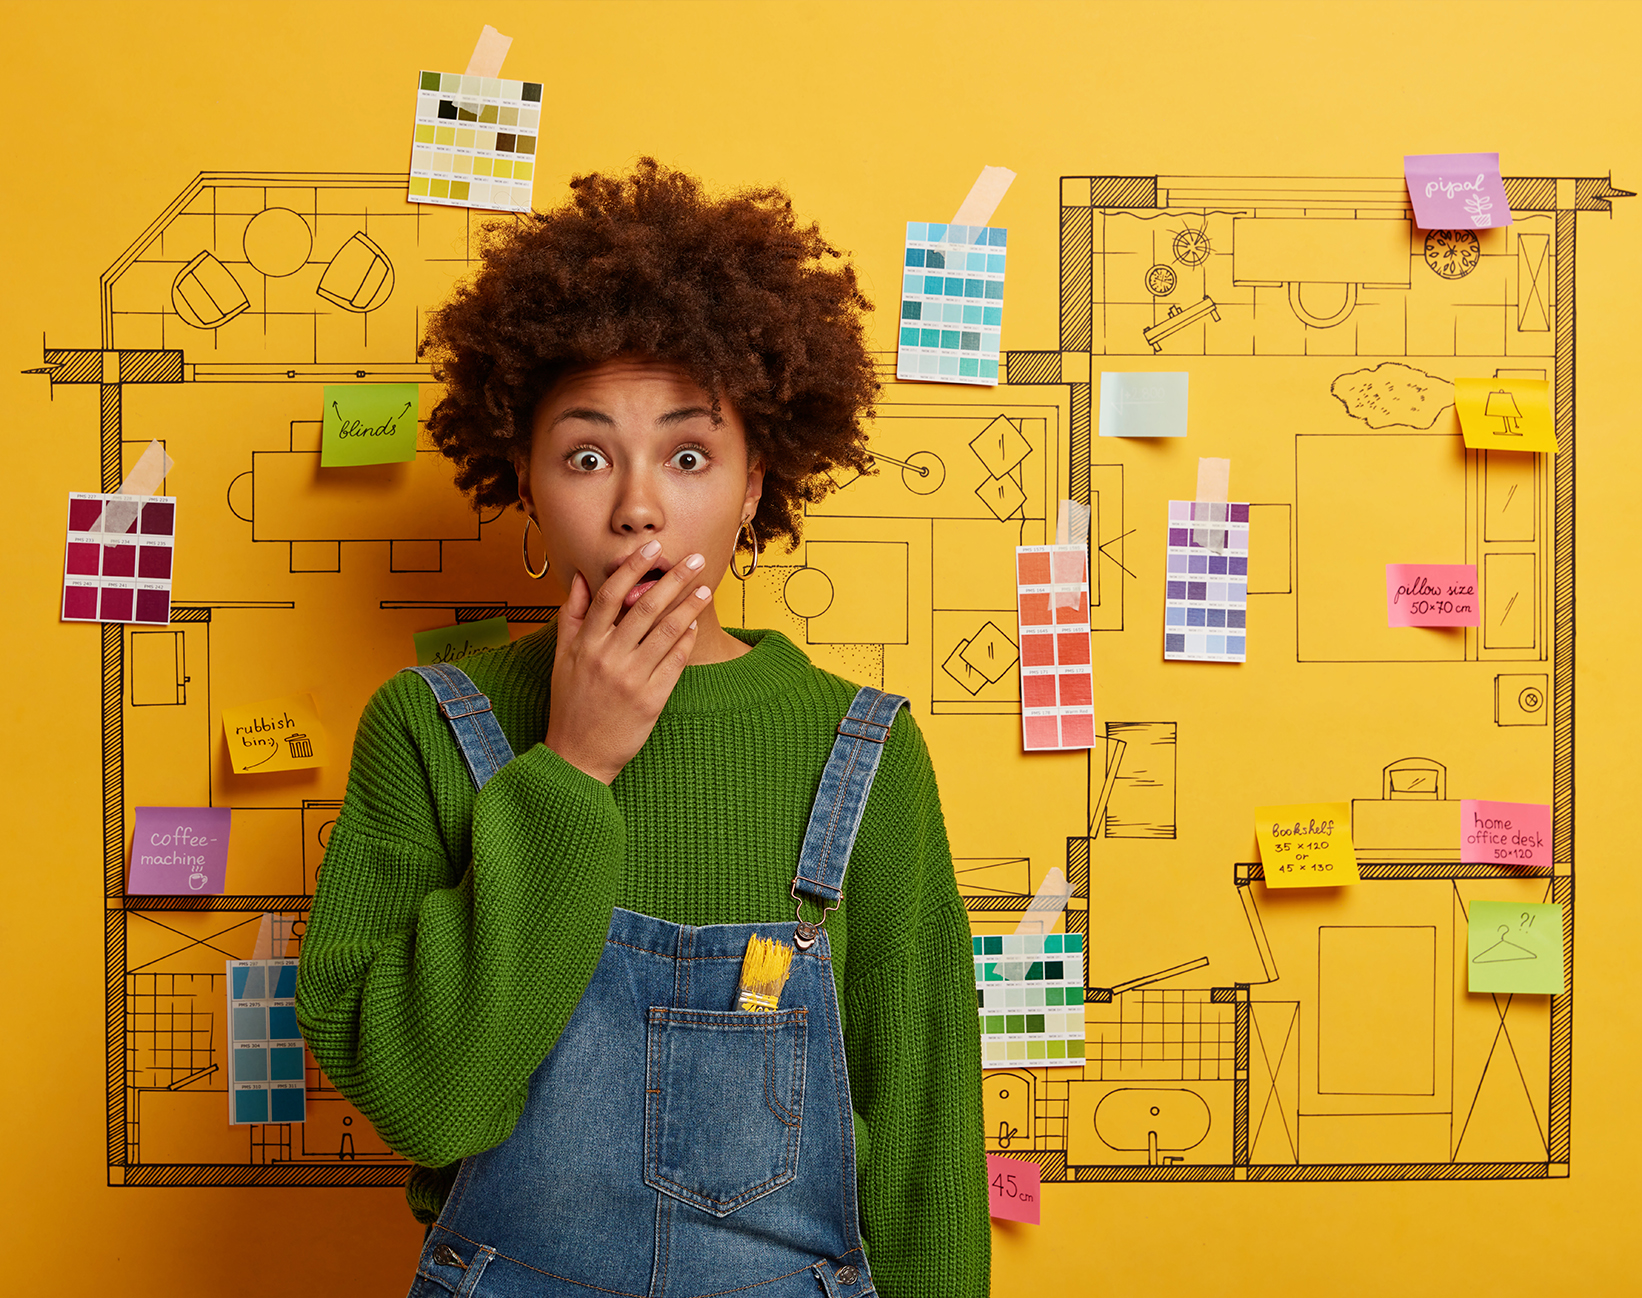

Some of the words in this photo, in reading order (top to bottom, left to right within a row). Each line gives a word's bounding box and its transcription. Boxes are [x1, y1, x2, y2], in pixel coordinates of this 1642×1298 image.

[1425, 173, 1484, 199] pipal
[339, 417, 396, 439] blinds
[1394, 576, 1441, 604] pillow
[1446, 581, 1474, 596] size
[431, 640, 489, 664] slidin
[236, 712, 295, 735] rubbish
[1272, 819, 1335, 838] bookshelf
[1474, 812, 1513, 830] home
[151, 826, 217, 846] coffee-
[1467, 830, 1508, 845] office
[1511, 829, 1544, 848] desk
[1275, 842, 1292, 853] 35
[141, 851, 205, 865] machine
[1279, 864, 1294, 873] 45
[1311, 863, 1334, 872] 130
[992, 1173, 1018, 1198] 45
[1019, 1193, 1033, 1202] cm
